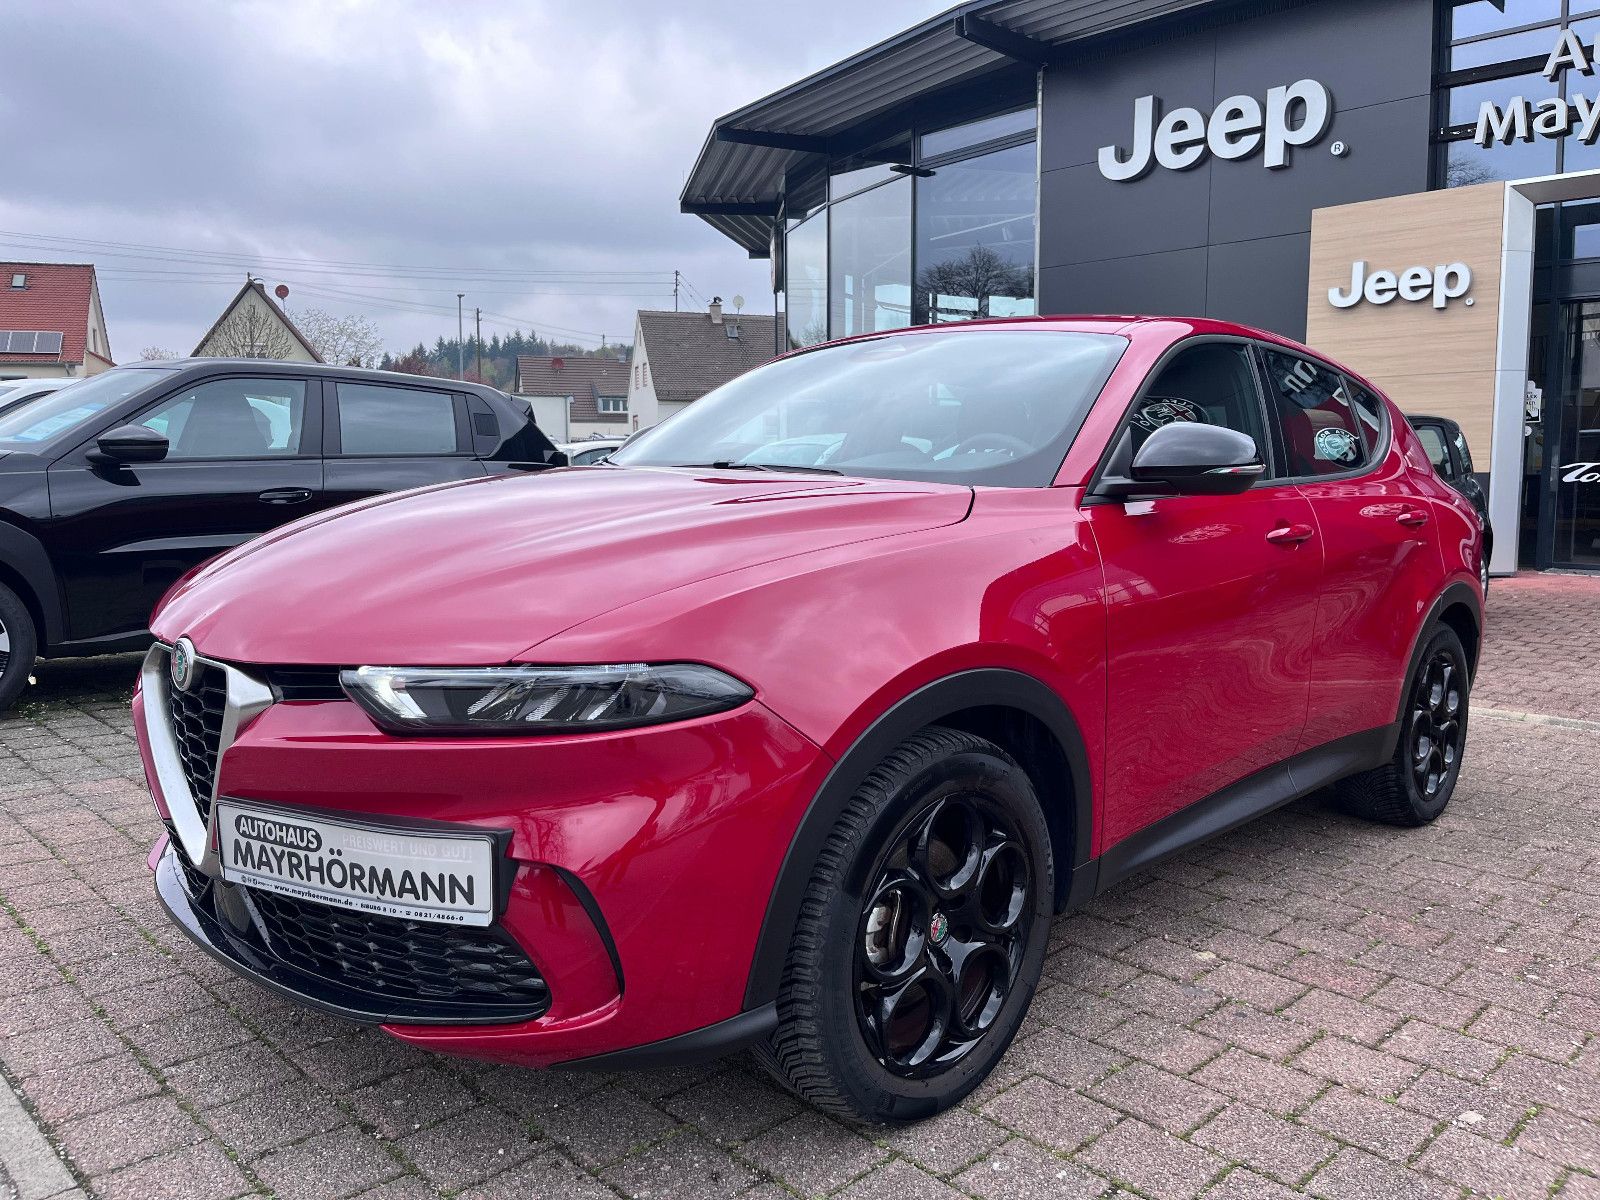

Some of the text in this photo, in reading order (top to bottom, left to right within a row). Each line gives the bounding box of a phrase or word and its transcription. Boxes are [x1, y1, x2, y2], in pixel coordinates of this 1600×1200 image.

[1097, 79, 1328, 181] Jeep
[1327, 261, 1471, 309] Jeep
[1559, 462, 1600, 483] To
[238, 816, 318, 849] AUTOHAUS
[342, 834, 405, 853] PREISWERT
[410, 842, 437, 857] UND
[232, 838, 475, 906] MAYRHÖRMANN
[274, 884, 353, 907] www.mayrhoermann.de
